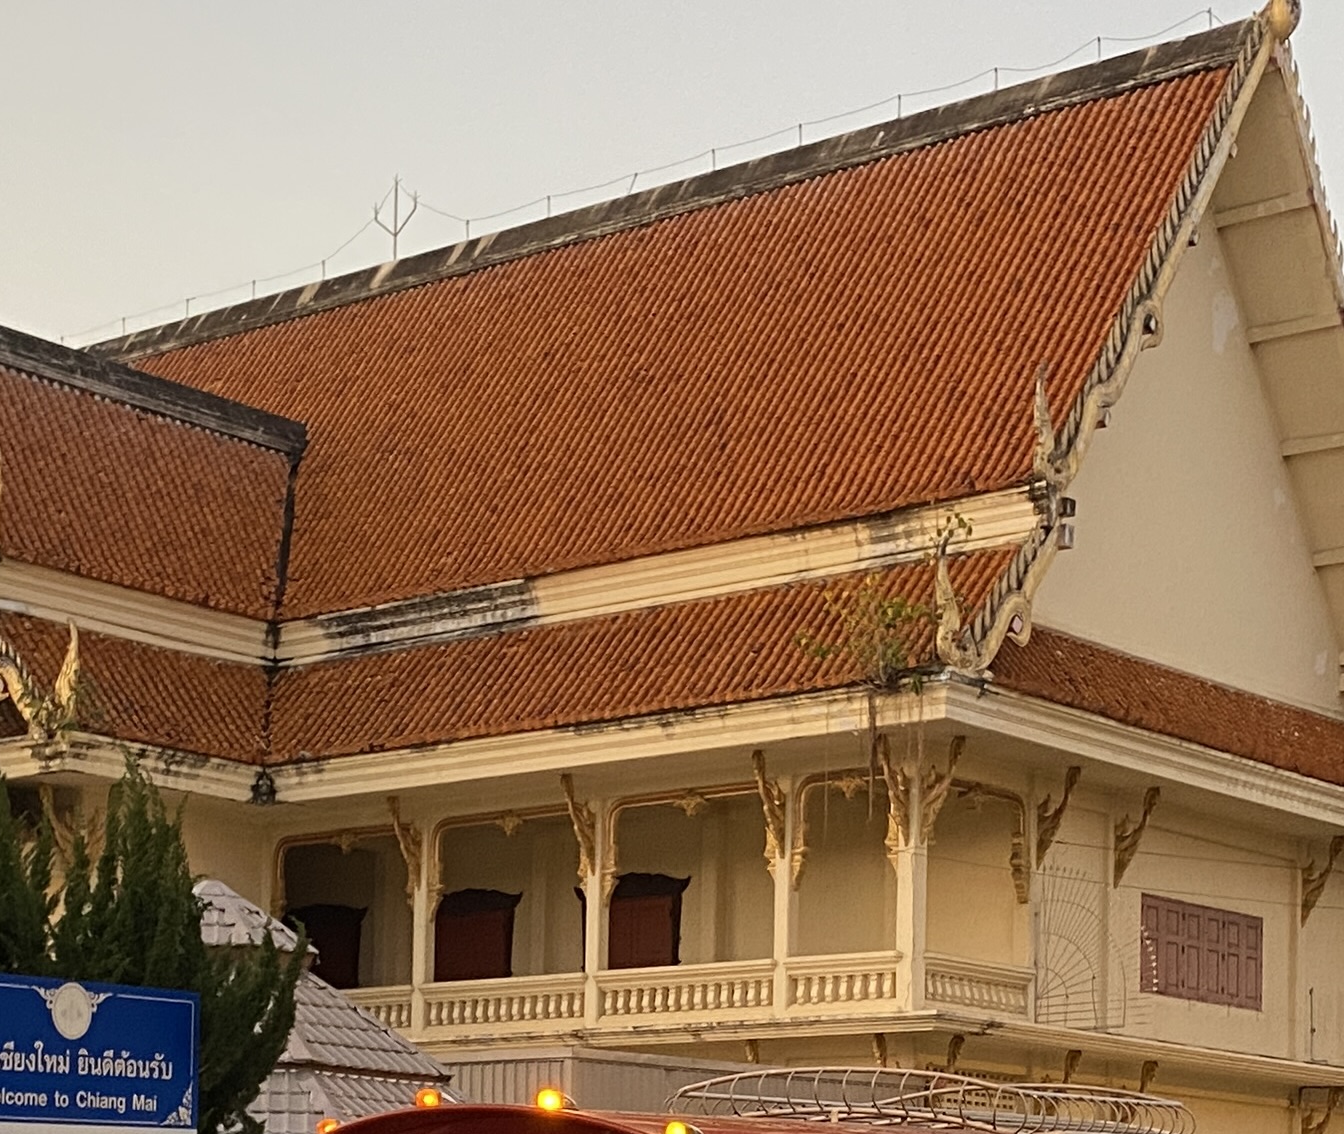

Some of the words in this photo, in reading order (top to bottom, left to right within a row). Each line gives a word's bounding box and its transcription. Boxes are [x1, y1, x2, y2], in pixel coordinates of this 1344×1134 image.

[77, 1048, 174, 1081] ยินดีต้อนรับ
[55, 1090, 69, 1108] to
[76, 1090, 126, 1115] Chiang
[132, 1094, 158, 1112] Mai
